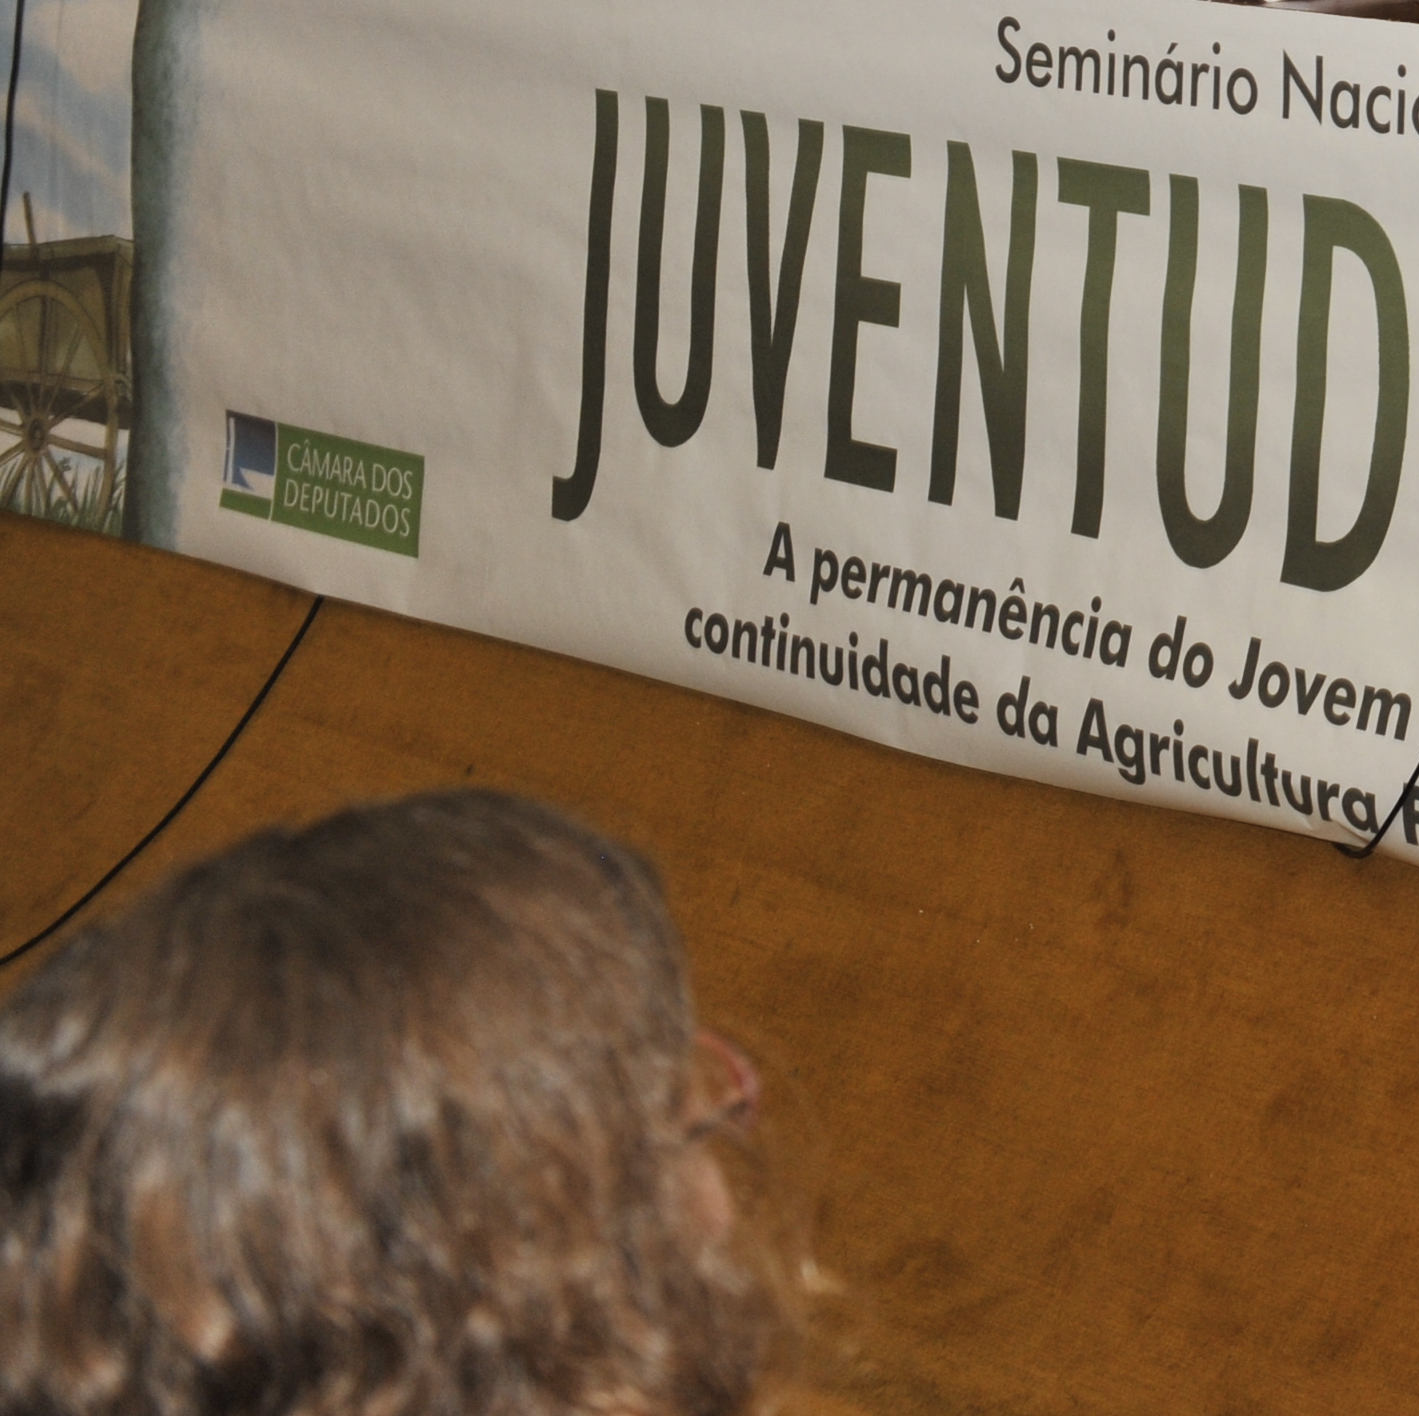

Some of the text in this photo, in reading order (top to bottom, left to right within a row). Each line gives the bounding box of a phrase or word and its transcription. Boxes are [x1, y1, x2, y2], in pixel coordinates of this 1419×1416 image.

[995, 15, 1259, 116] Seminário
[283, 478, 411, 537] DEPUTADOS
[286, 438, 413, 500] CÂMARA DOS
[762, 521, 796, 582] A
[809, 547, 1133, 668] permanência
[1147, 614, 1215, 689] do
[1228, 636, 1413, 741] Jovem
[683, 606, 981, 726] continuidade
[995, 675, 1060, 748] da
[1075, 697, 1381, 835] Agricultura
